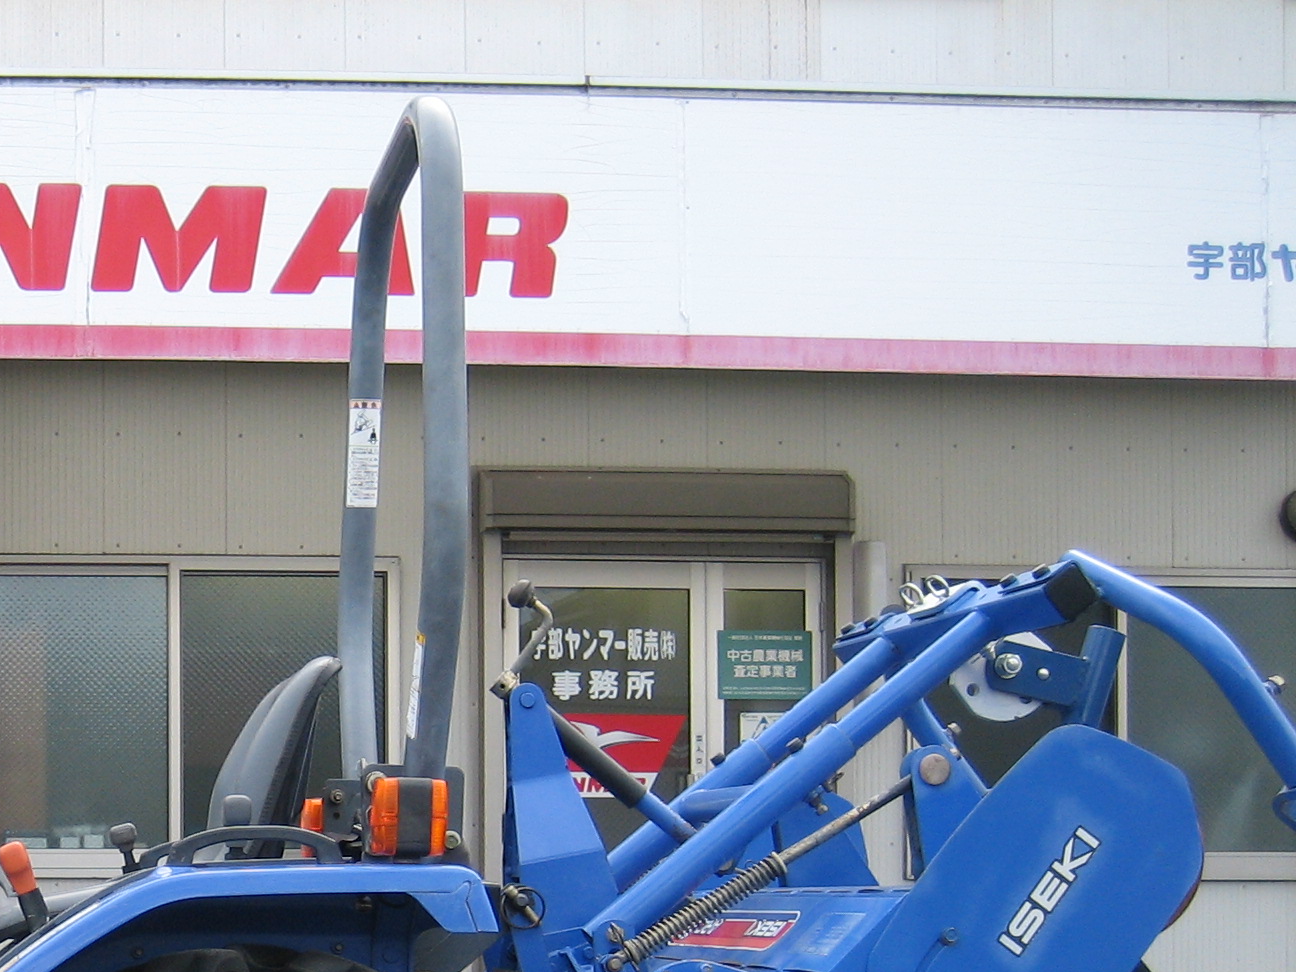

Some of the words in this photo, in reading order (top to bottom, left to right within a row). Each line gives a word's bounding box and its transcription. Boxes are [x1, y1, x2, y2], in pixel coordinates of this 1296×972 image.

[552, 670, 655, 700] 事務所
[997, 825, 1101, 957] ISEKI
